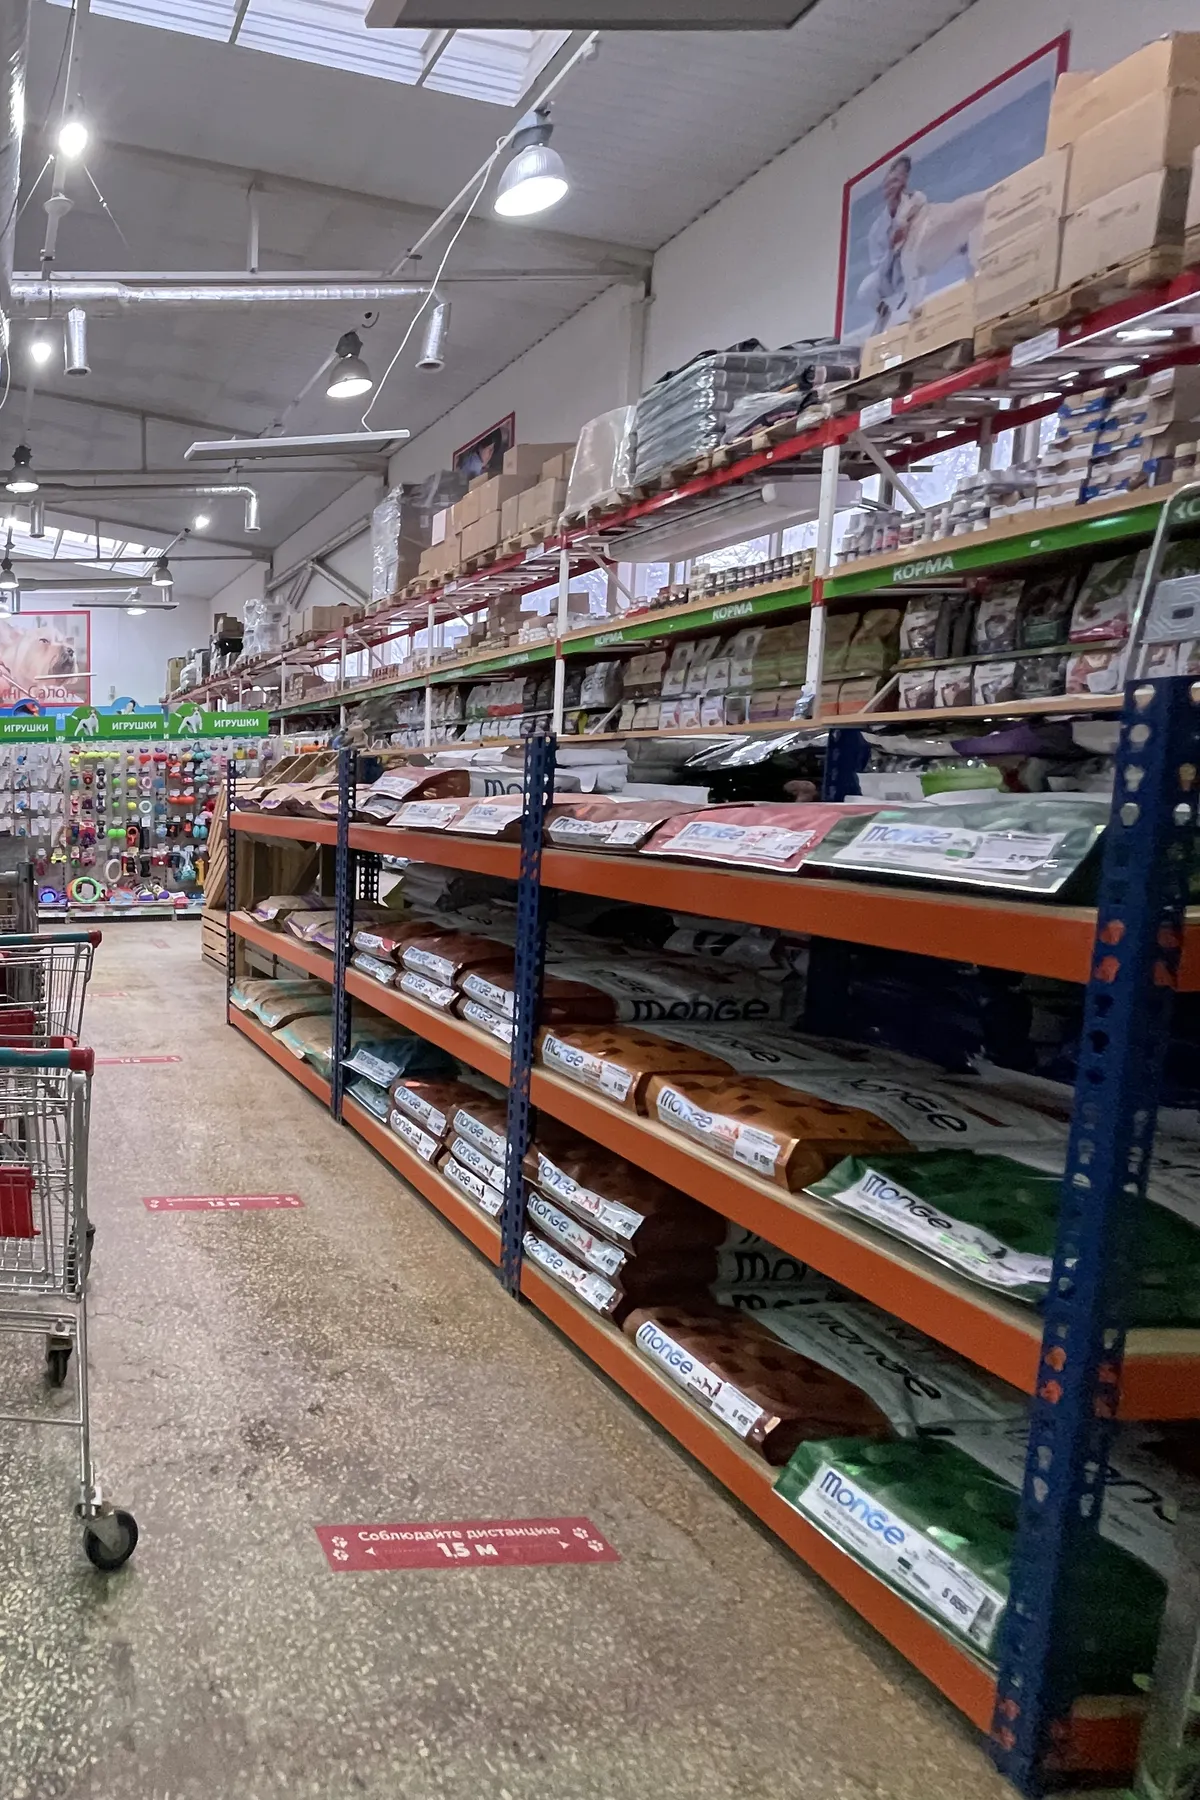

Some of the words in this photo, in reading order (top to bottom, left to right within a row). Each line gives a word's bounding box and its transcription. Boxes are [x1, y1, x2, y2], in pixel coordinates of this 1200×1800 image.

[893, 556, 954, 581] КОРМА
[713, 602, 753, 620] КОРМА
[595, 632, 623, 645] КОРМА
[28, 685, 75, 699] Салон
[4, 723, 49, 733] ИГРУШКИ
[112, 721, 157, 731] ИГРУШКИ
[213, 718, 259, 728] ИГРУШКИ
[358, 1528, 461, 1543] Соблюдайте
[467, 1526, 560, 1541] дистанцию
